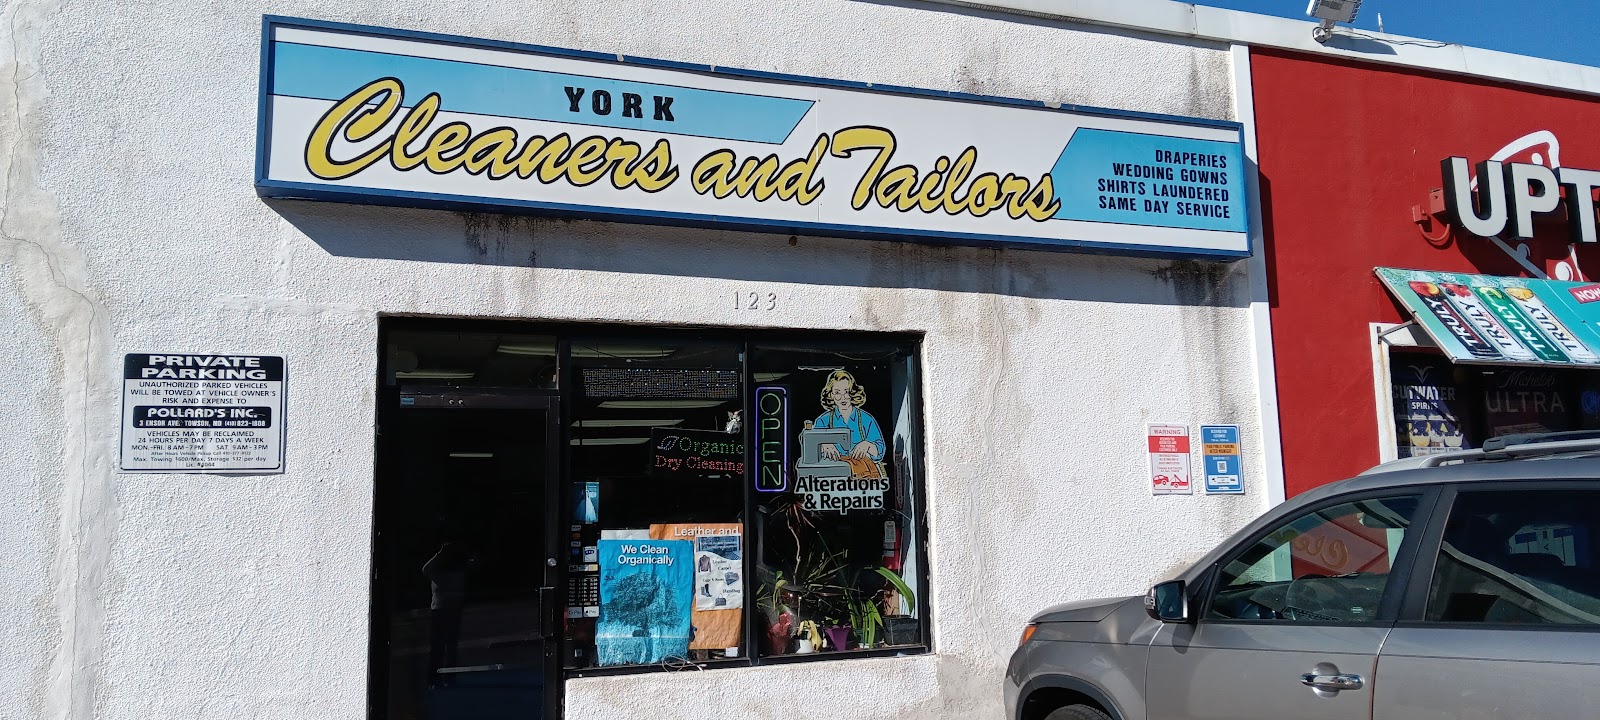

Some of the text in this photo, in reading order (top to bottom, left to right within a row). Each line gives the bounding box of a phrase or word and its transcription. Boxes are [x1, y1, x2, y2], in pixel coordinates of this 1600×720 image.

[563, 86, 676, 123] YORK
[304, 76, 1062, 222] Cleaners and Tailors
[1155, 149, 1227, 169] DRAPERIES
[1113, 163, 1227, 185] WEDDING GOWNS
[1098, 178, 1229, 201] SHIRTS LAUNDERED
[1442, 155, 1600, 243] UPT
[1099, 196, 1230, 218] SAME DAY SERVICE
[731, 291, 778, 311] 123
[1424, 298, 1480, 347] TRULY
[1459, 301, 1512, 349] TRULY
[1492, 301, 1545, 351] TRULY
[1525, 304, 1577, 351] TRULY
[149, 355, 260, 368] PRIVATE
[142, 368, 266, 379] PARKING
[1392, 385, 1456, 401] CUTWATER
[1485, 391, 1565, 413] ULTRA
[148, 408, 257, 418] POLLARD'S INC.
[679, 437, 744, 456] Organic
[760, 393, 781, 486] OPEN
[655, 455, 744, 474] Dry Cleaning
[796, 475, 889, 492] Alterations
[804, 492, 882, 514] & Repairs
[674, 526, 739, 536] Leather and
[618, 555, 674, 566] Organically
[621, 545, 668, 554] We Clean
